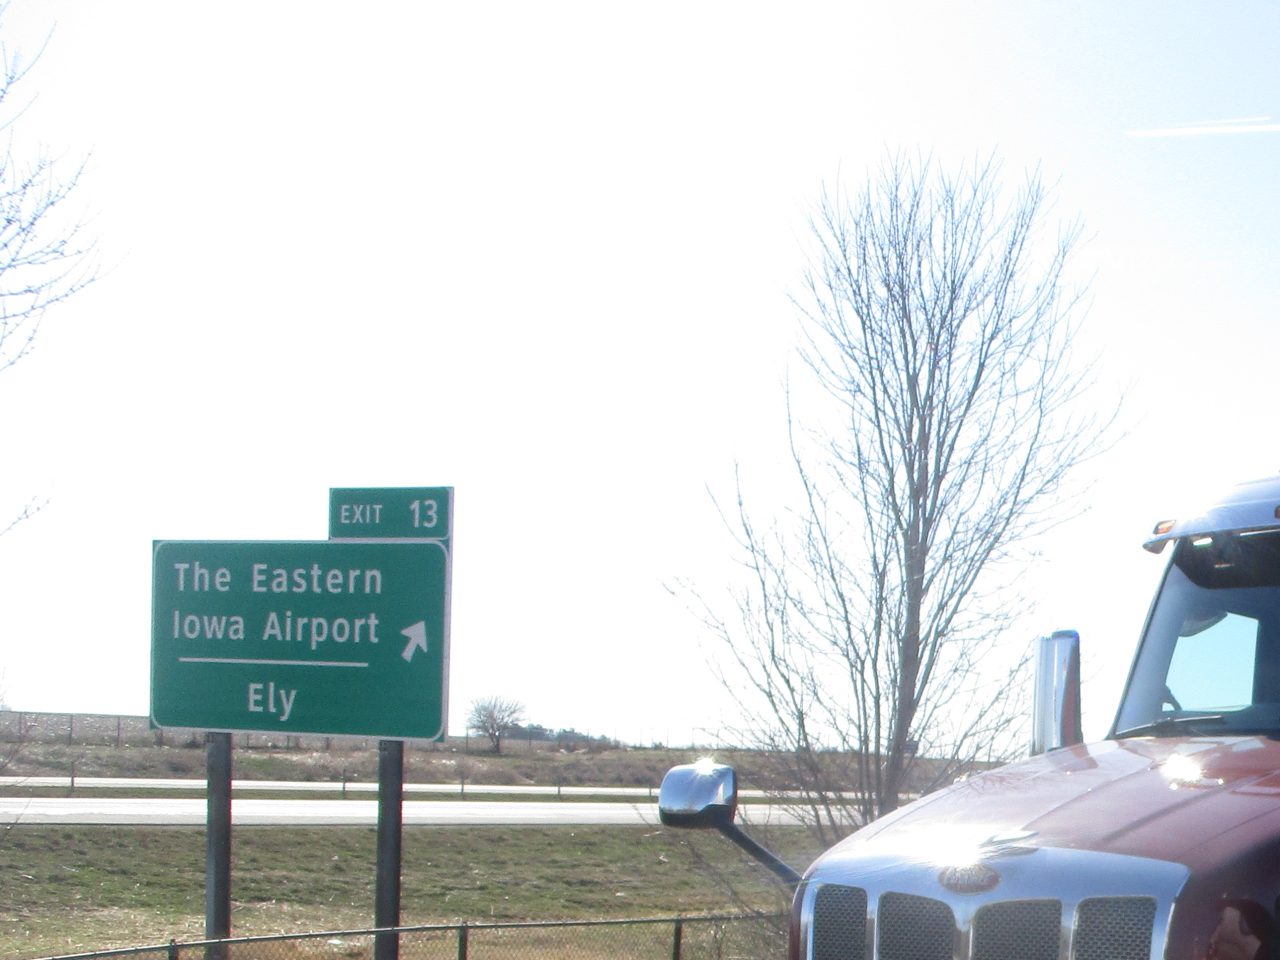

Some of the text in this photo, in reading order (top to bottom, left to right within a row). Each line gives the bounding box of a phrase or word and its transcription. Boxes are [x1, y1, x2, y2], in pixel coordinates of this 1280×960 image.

[340, 499, 439, 528] EXIT 13
[174, 562, 383, 594] The Eastern
[173, 610, 380, 650] Iowa Airport
[247, 682, 297, 722] Ely
